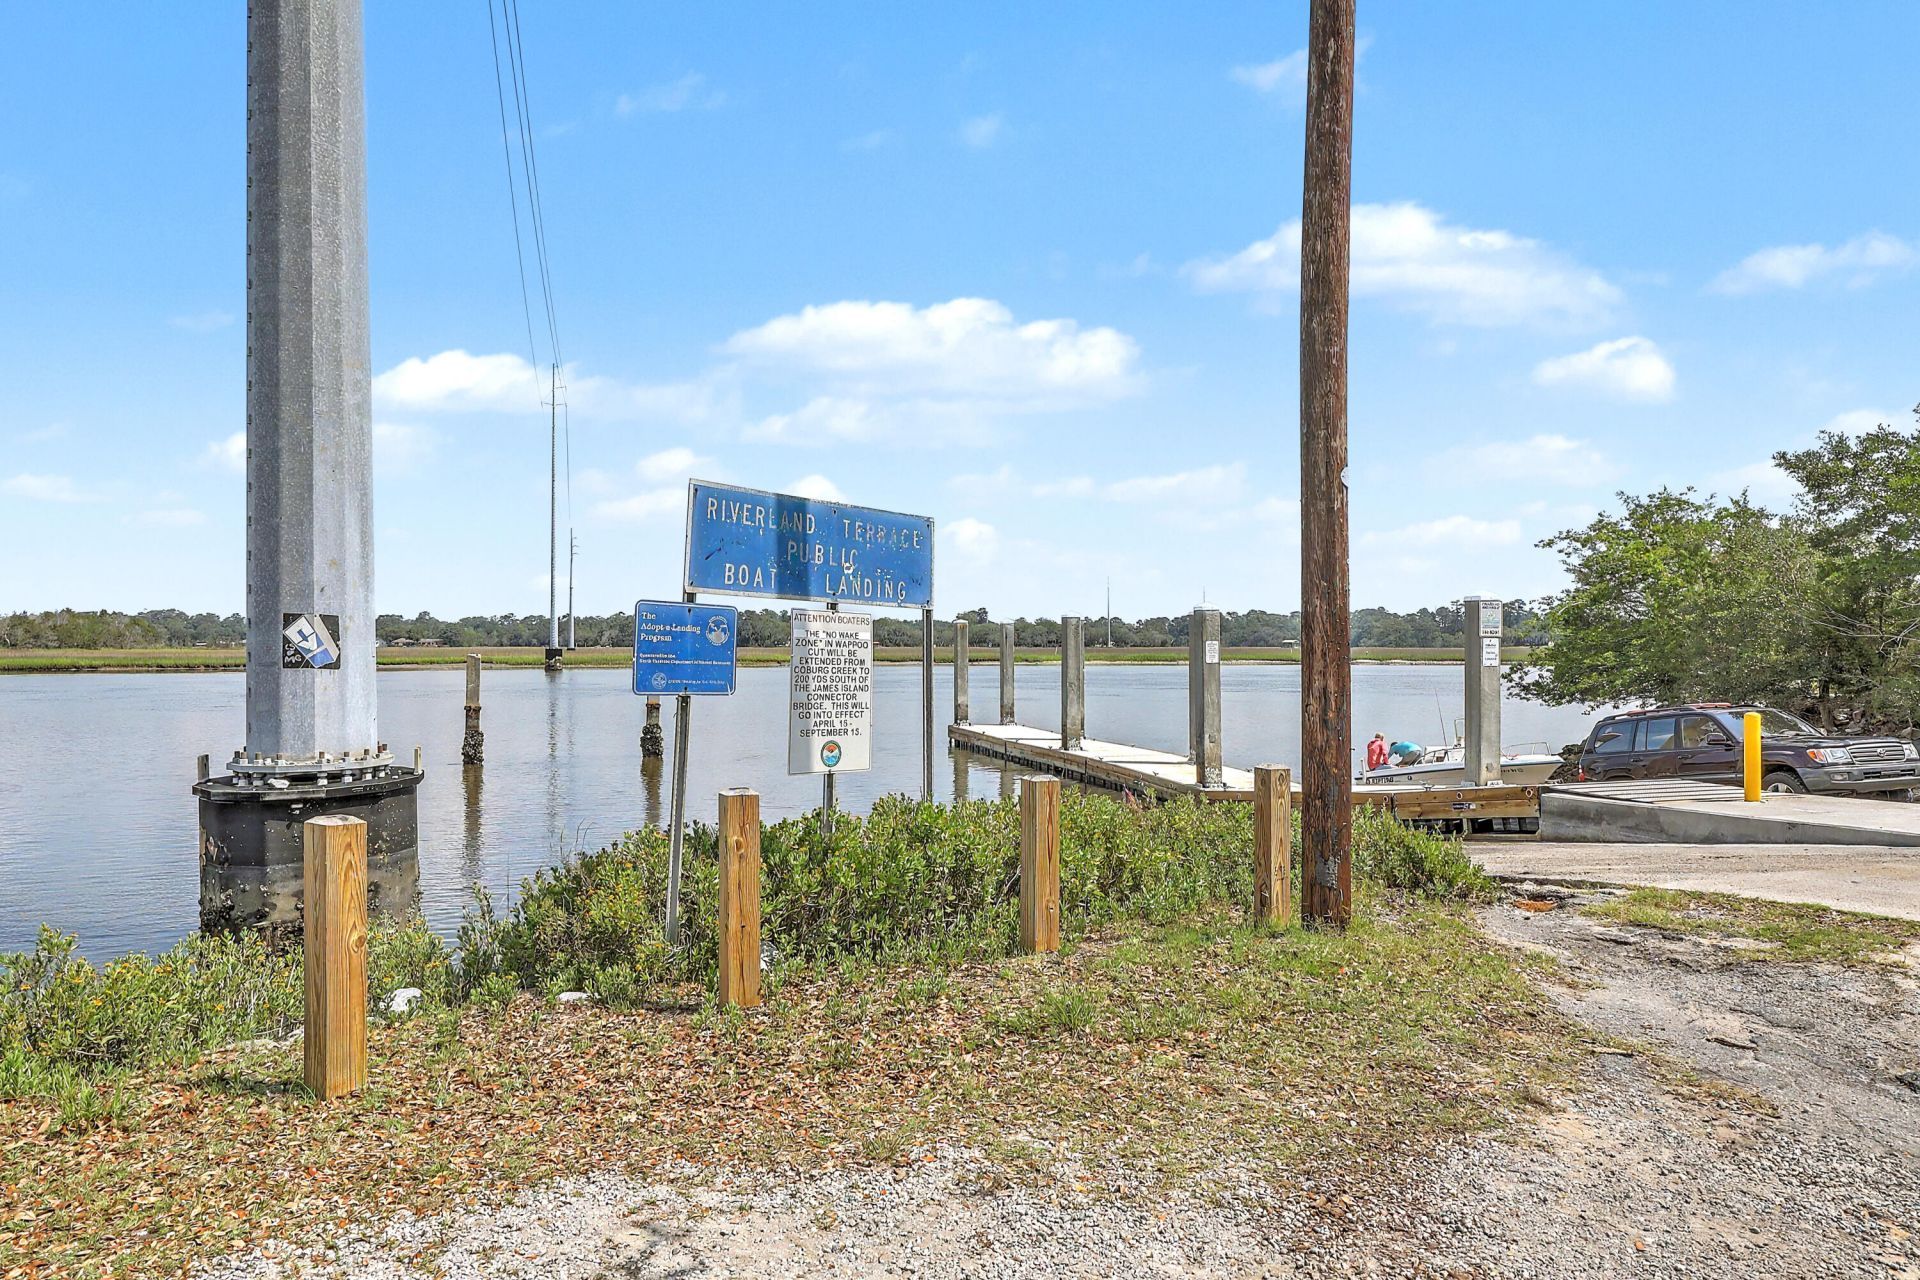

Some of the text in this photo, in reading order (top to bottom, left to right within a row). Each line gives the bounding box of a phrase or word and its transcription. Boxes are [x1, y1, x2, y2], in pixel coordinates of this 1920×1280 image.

[707, 497, 816, 534] RIVERLAND
[788, 540, 858, 567] PUBLIC
[724, 563, 906, 600] BOAT LANDING
[794, 613, 870, 626] ATTENTION BOATERS
[640, 633, 672, 642] Program
[805, 630, 820, 638] THE
[822, 630, 836, 638] "NO
[796, 639, 822, 647] ZONE"
[835, 640, 868, 649] WAPPOO
[808, 648, 825, 656] CUT
[800, 657, 841, 665] EXTENDED
[794, 666, 829, 674] COBURG
[795, 675, 809, 683] 200
[794, 684, 810, 692] THE
[813, 684, 839, 692] JAMES
[793, 702, 827, 711] BRIDGE.
[799, 711, 811, 719] GO
[813, 720, 836, 728] APRIL
[800, 728, 848, 737] SEPTEMBER
